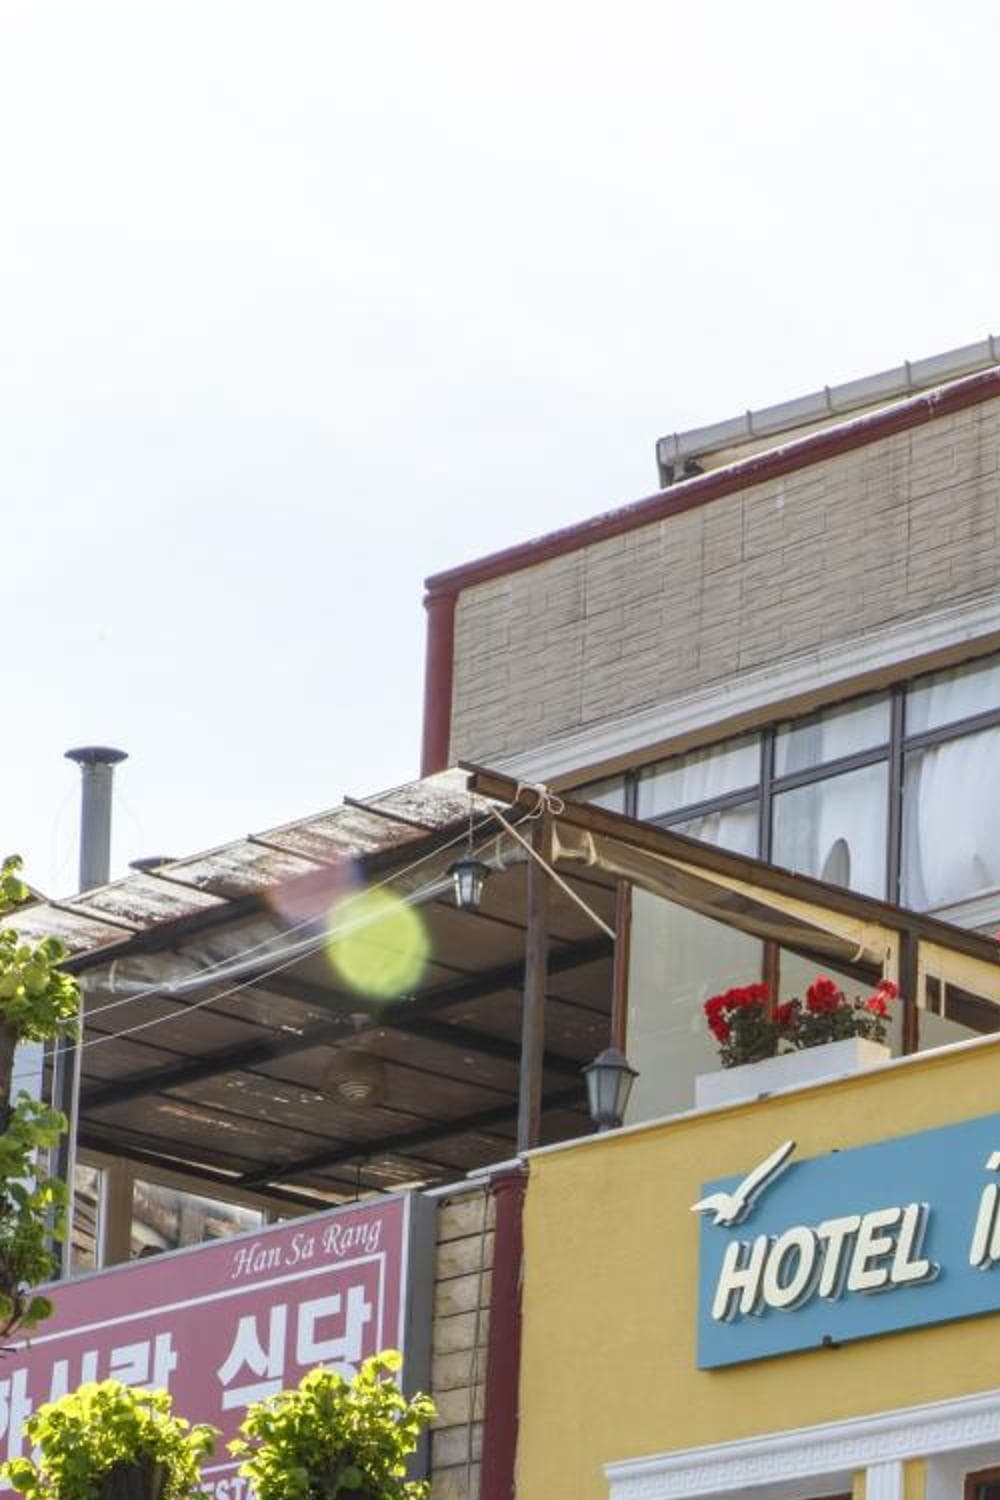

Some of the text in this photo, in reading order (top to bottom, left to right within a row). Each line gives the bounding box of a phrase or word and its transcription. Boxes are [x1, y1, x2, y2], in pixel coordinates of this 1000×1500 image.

[231, 1218, 382, 1279] Han Sa Rang
[711, 1202, 940, 1322] HOTEL
